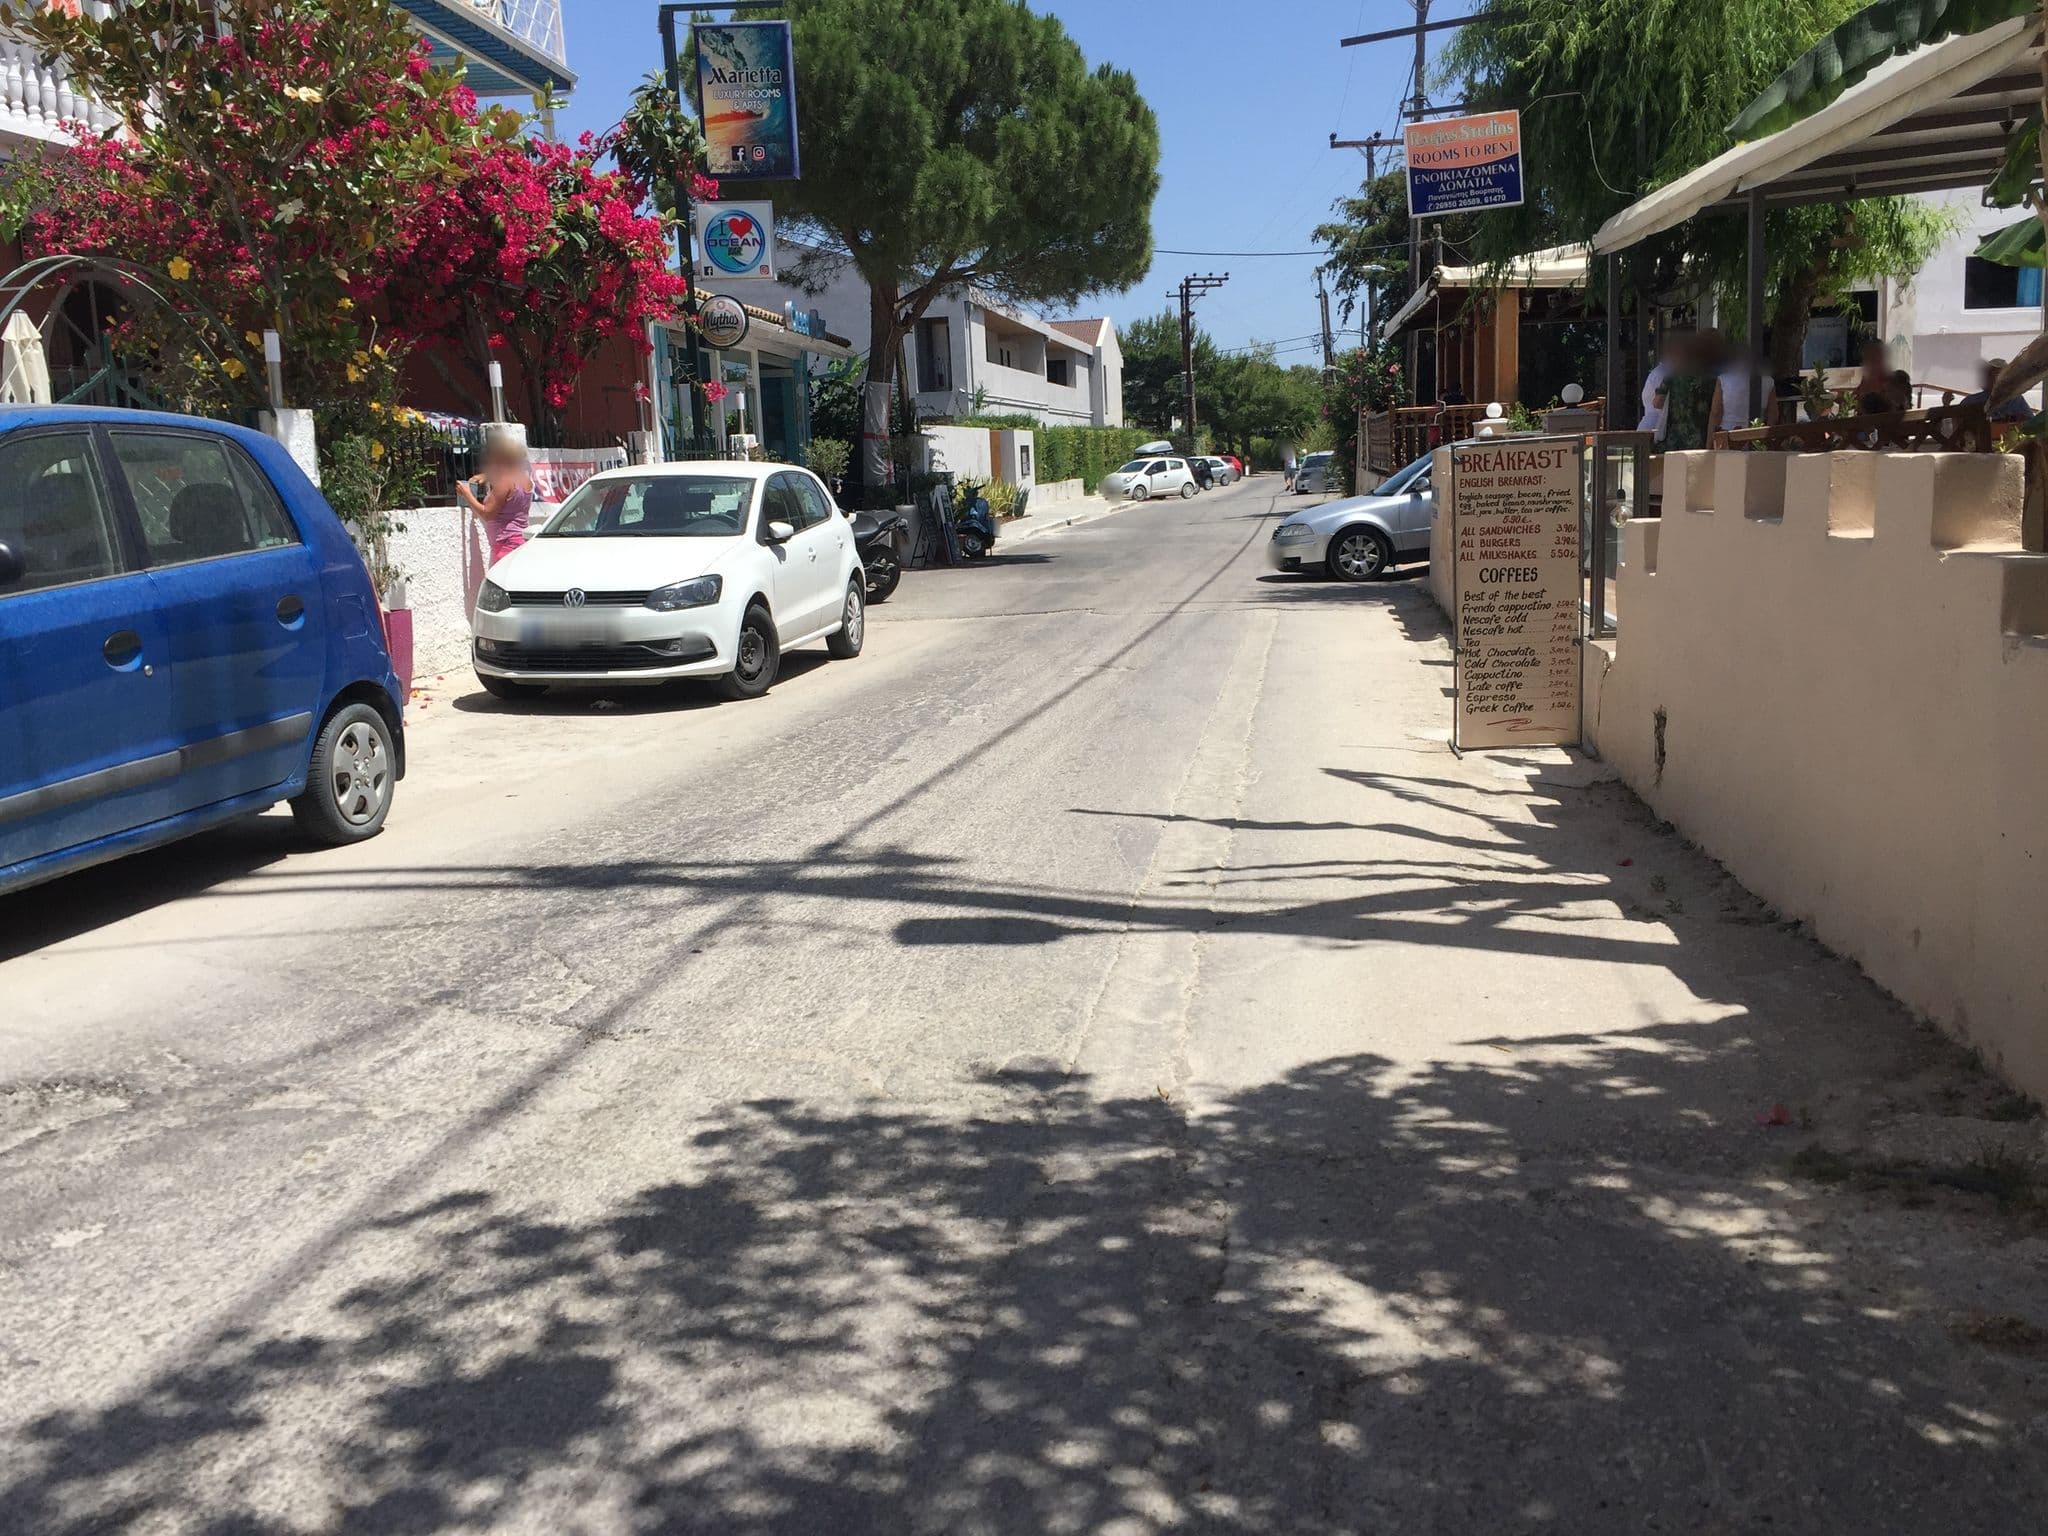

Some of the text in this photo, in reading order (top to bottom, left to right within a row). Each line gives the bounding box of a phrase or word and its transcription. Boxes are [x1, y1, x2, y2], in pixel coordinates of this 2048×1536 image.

[707, 67, 782, 85] Marietta
[713, 88, 782, 100] LUXURY ROOMS
[1412, 140, 1514, 165] ROOMS TO RENT
[1414, 163, 1515, 185] ΕΝΟΙΚΙΑΖΟΜΕΝΑ
[707, 237, 762, 247] OCEAN
[704, 311, 739, 332] Mythos
[1461, 449, 1567, 473] BREAKFAST
[1460, 476, 1545, 488] ENGLISH BREAKFAST:
[1459, 493, 1482, 503] English
[1548, 489, 1570, 497] fried
[1461, 526, 1475, 536] ALL
[1480, 524, 1541, 536] SANDWICHES
[1461, 540, 1474, 548] ALL
[1480, 539, 1520, 547] BURGERS
[1460, 552, 1475, 561] ALL
[1480, 550, 1536, 560] MILKSHAKES
[1480, 567, 1538, 583] COFFEES
[1464, 589, 1547, 601] Best of the best
[1505, 613, 1528, 623] cold
[1507, 625, 1523, 634] hot
[1464, 638, 1480, 647] Tea
[1464, 648, 1480, 657] Hot
[1465, 659, 1488, 669] Cold
[1492, 657, 1541, 667] Chocolate
[1467, 681, 1491, 691] Late
[1466, 692, 1516, 704] Espresso
[1466, 703, 1499, 715] Greek
